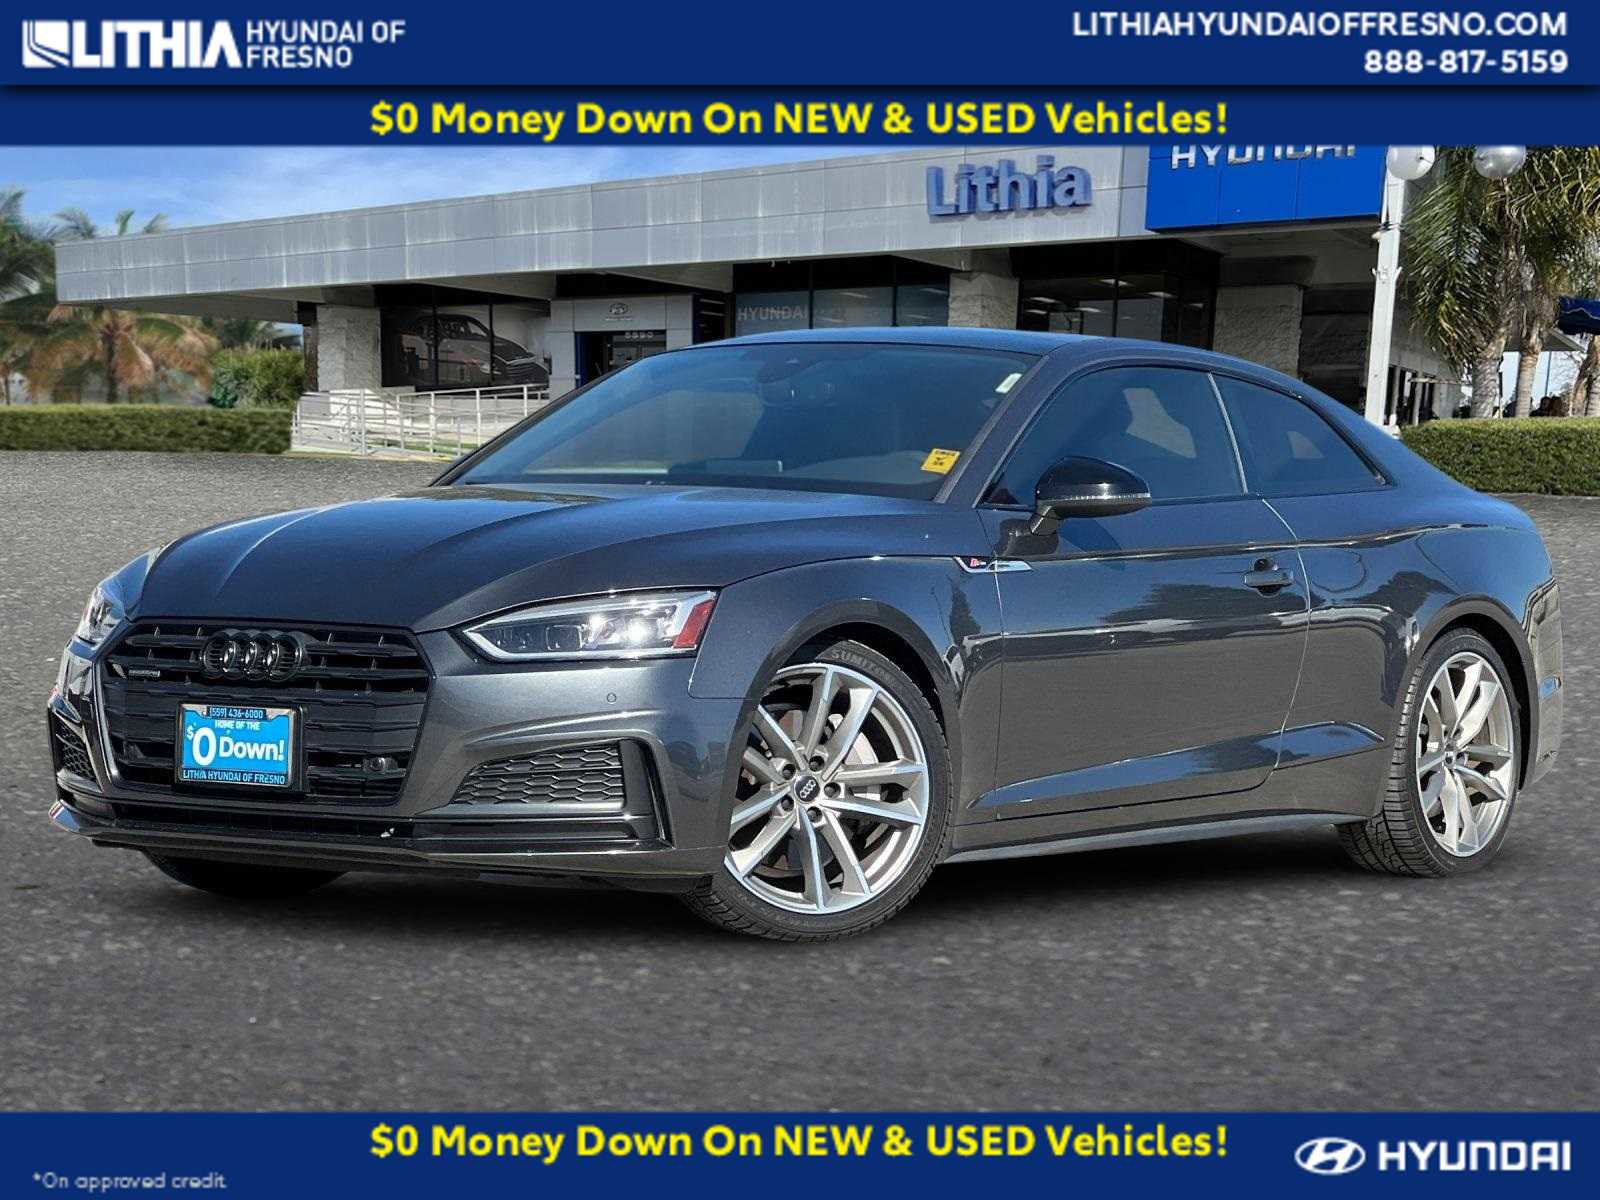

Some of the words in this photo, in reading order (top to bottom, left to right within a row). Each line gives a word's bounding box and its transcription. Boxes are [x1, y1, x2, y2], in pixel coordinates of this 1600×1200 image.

[926, 154, 1092, 217] Lithia
[737, 305, 809, 321] HYUNDAI
[229, 708, 264, 719] 436-6000
[214, 719, 235, 729] HOME
[235, 720, 246, 730] OF
[247, 721, 260, 731] THE
[219, 736, 285, 761] Down!
[182, 769, 207, 780] LITHIA
[207, 770, 241, 782] HYUNDAI
[242, 773, 254, 783] OF
[254, 773, 286, 786] FRESNO
